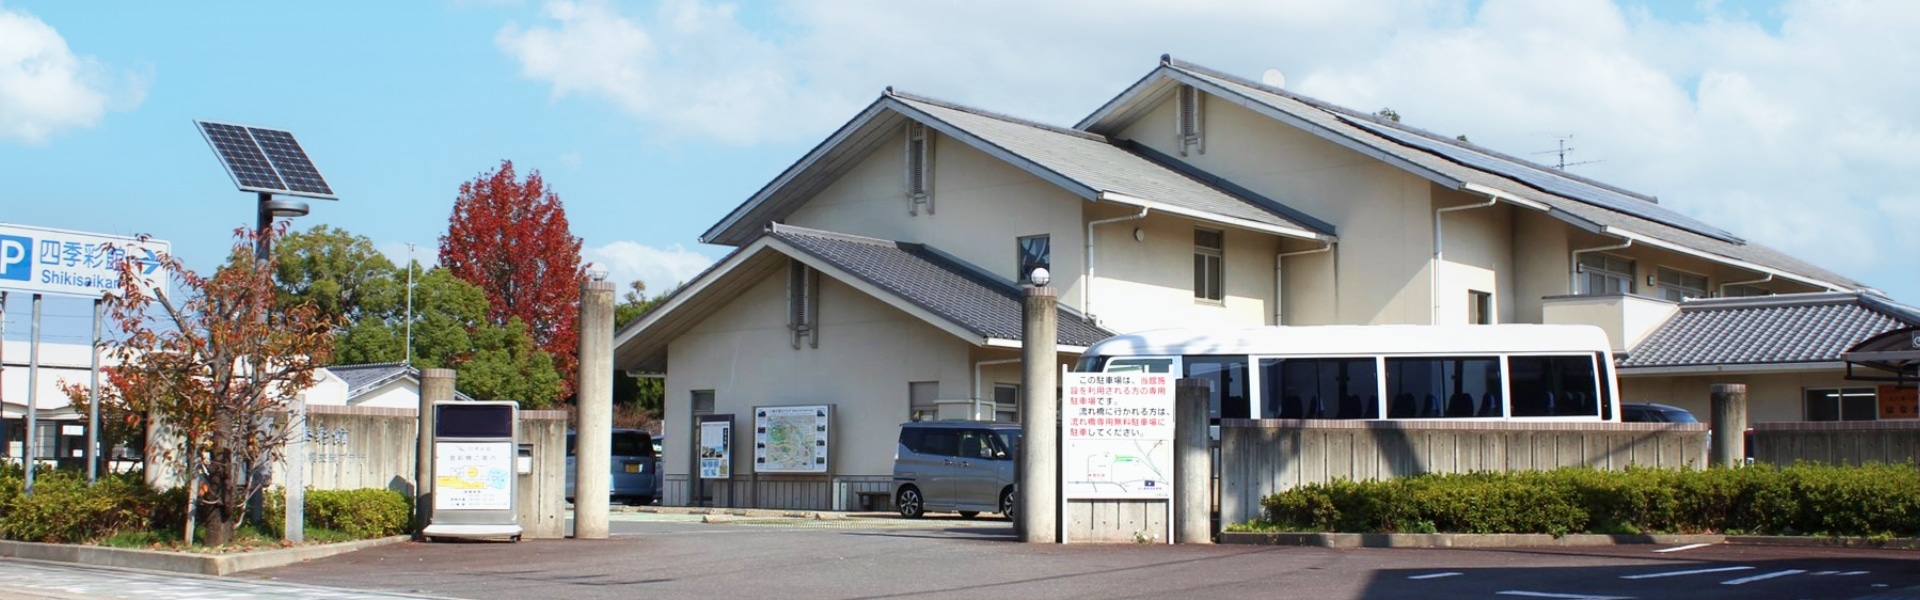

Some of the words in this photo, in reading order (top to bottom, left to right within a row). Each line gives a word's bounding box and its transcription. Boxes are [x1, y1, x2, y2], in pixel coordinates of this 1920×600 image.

[1, 239, 26, 275] P
[40, 239, 126, 272] 四季彩館
[1070, 386, 1166, 395] 設を利用される方の専用
[1070, 397, 1118, 406] 駐車場です。
[1079, 407, 1170, 416] 流れ橋に行かれる方は、
[1070, 418, 1165, 427] 流れ橋専用無料駐車場に
[1070, 428, 1144, 438] 駐車してください。
